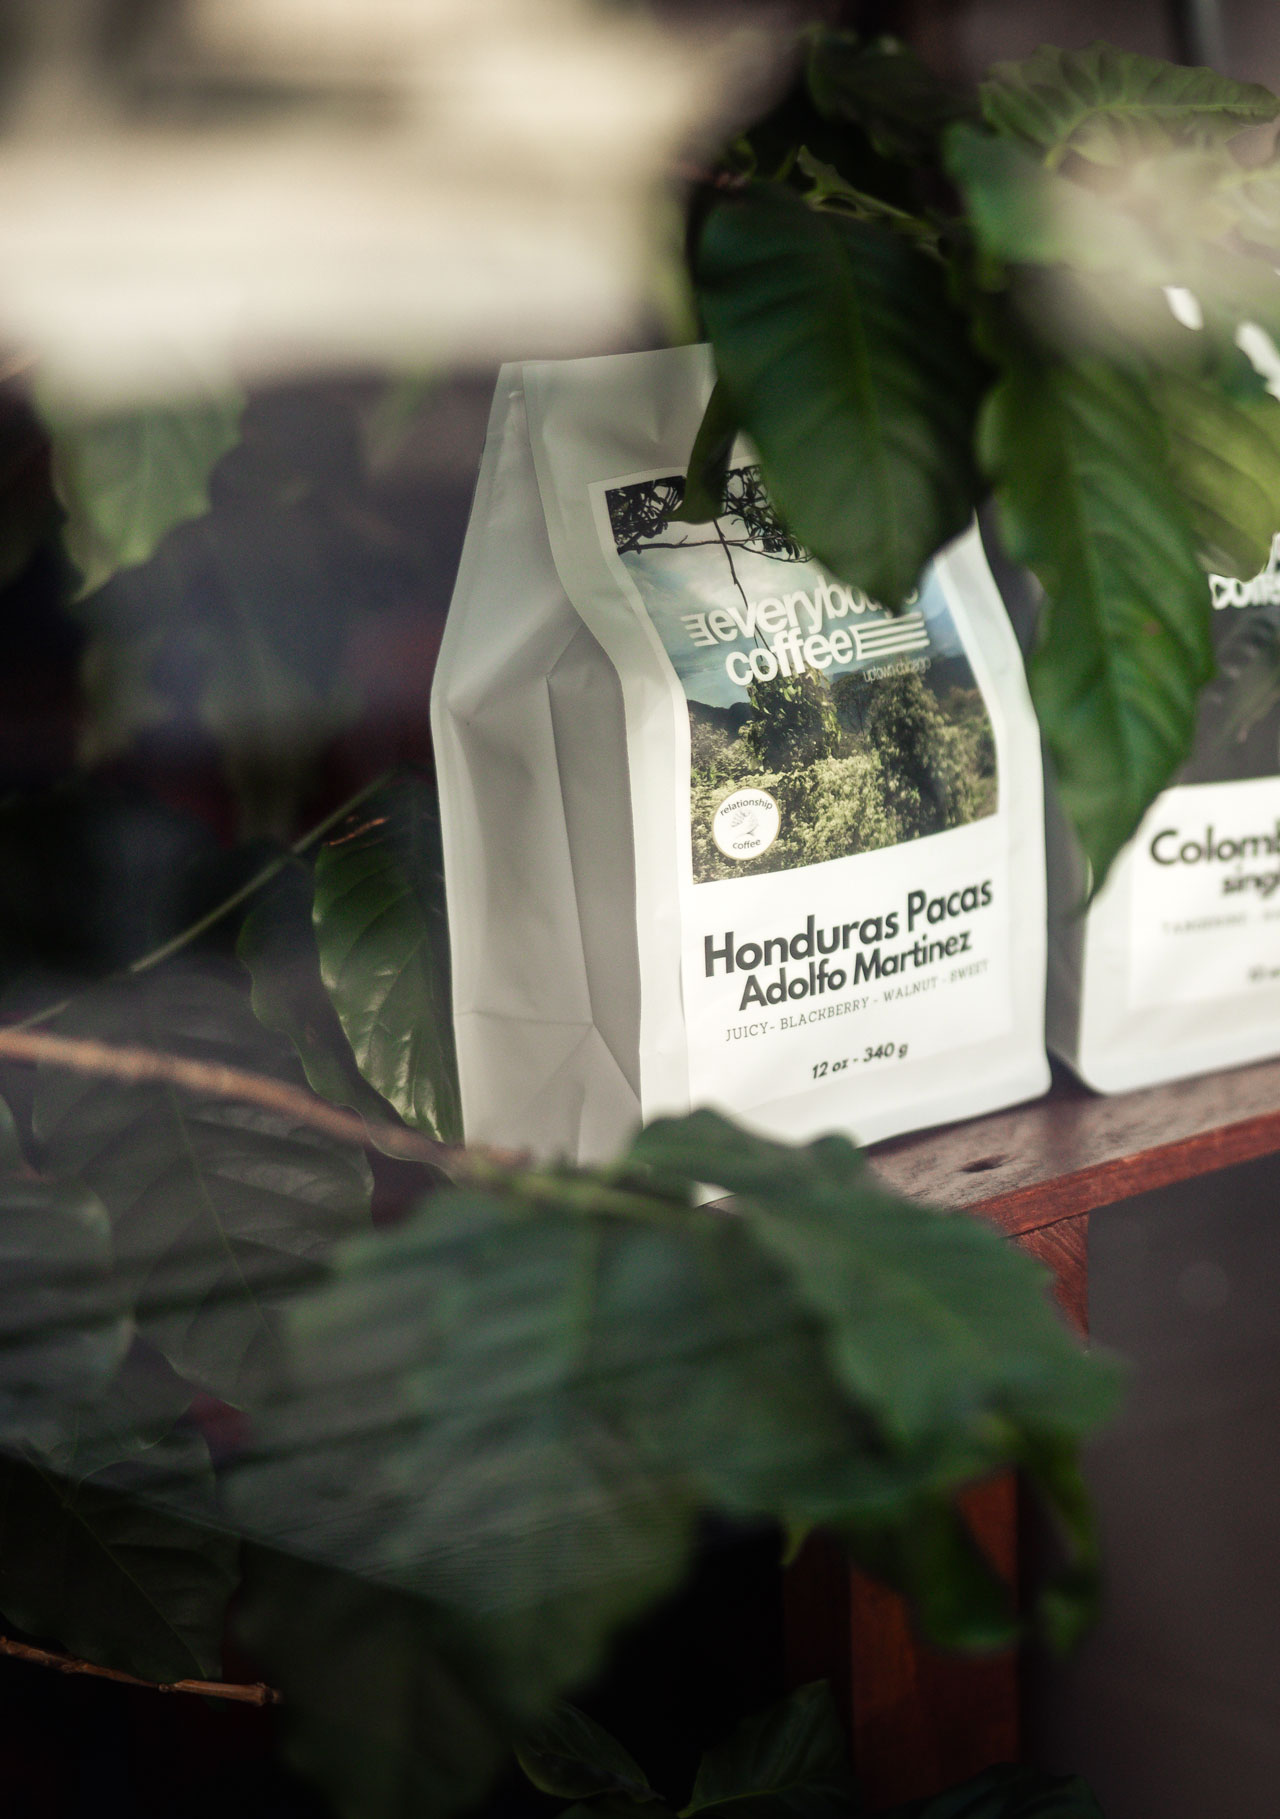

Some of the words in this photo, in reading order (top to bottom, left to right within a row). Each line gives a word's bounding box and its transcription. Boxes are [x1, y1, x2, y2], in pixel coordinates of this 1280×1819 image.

[726, 628, 853, 686] coffee
[863, 664, 895, 684] uptown
[720, 799, 773, 816] relationship
[732, 840, 760, 849] coffee
[704, 914, 899, 978] Honduras
[907, 879, 993, 933] Pacas
[738, 959, 847, 1012] Adolfo
[853, 929, 973, 985] Martinez
[780, 996, 869, 1031] BLACKBERRY
[883, 976, 938, 1002] WALNUT
[950, 959, 989, 984] SWEET
[812, 1060, 828, 1079] 12
[832, 1057, 848, 1073] oz
[863, 1041, 895, 1063] 340
[898, 1043, 909, 1059] g
